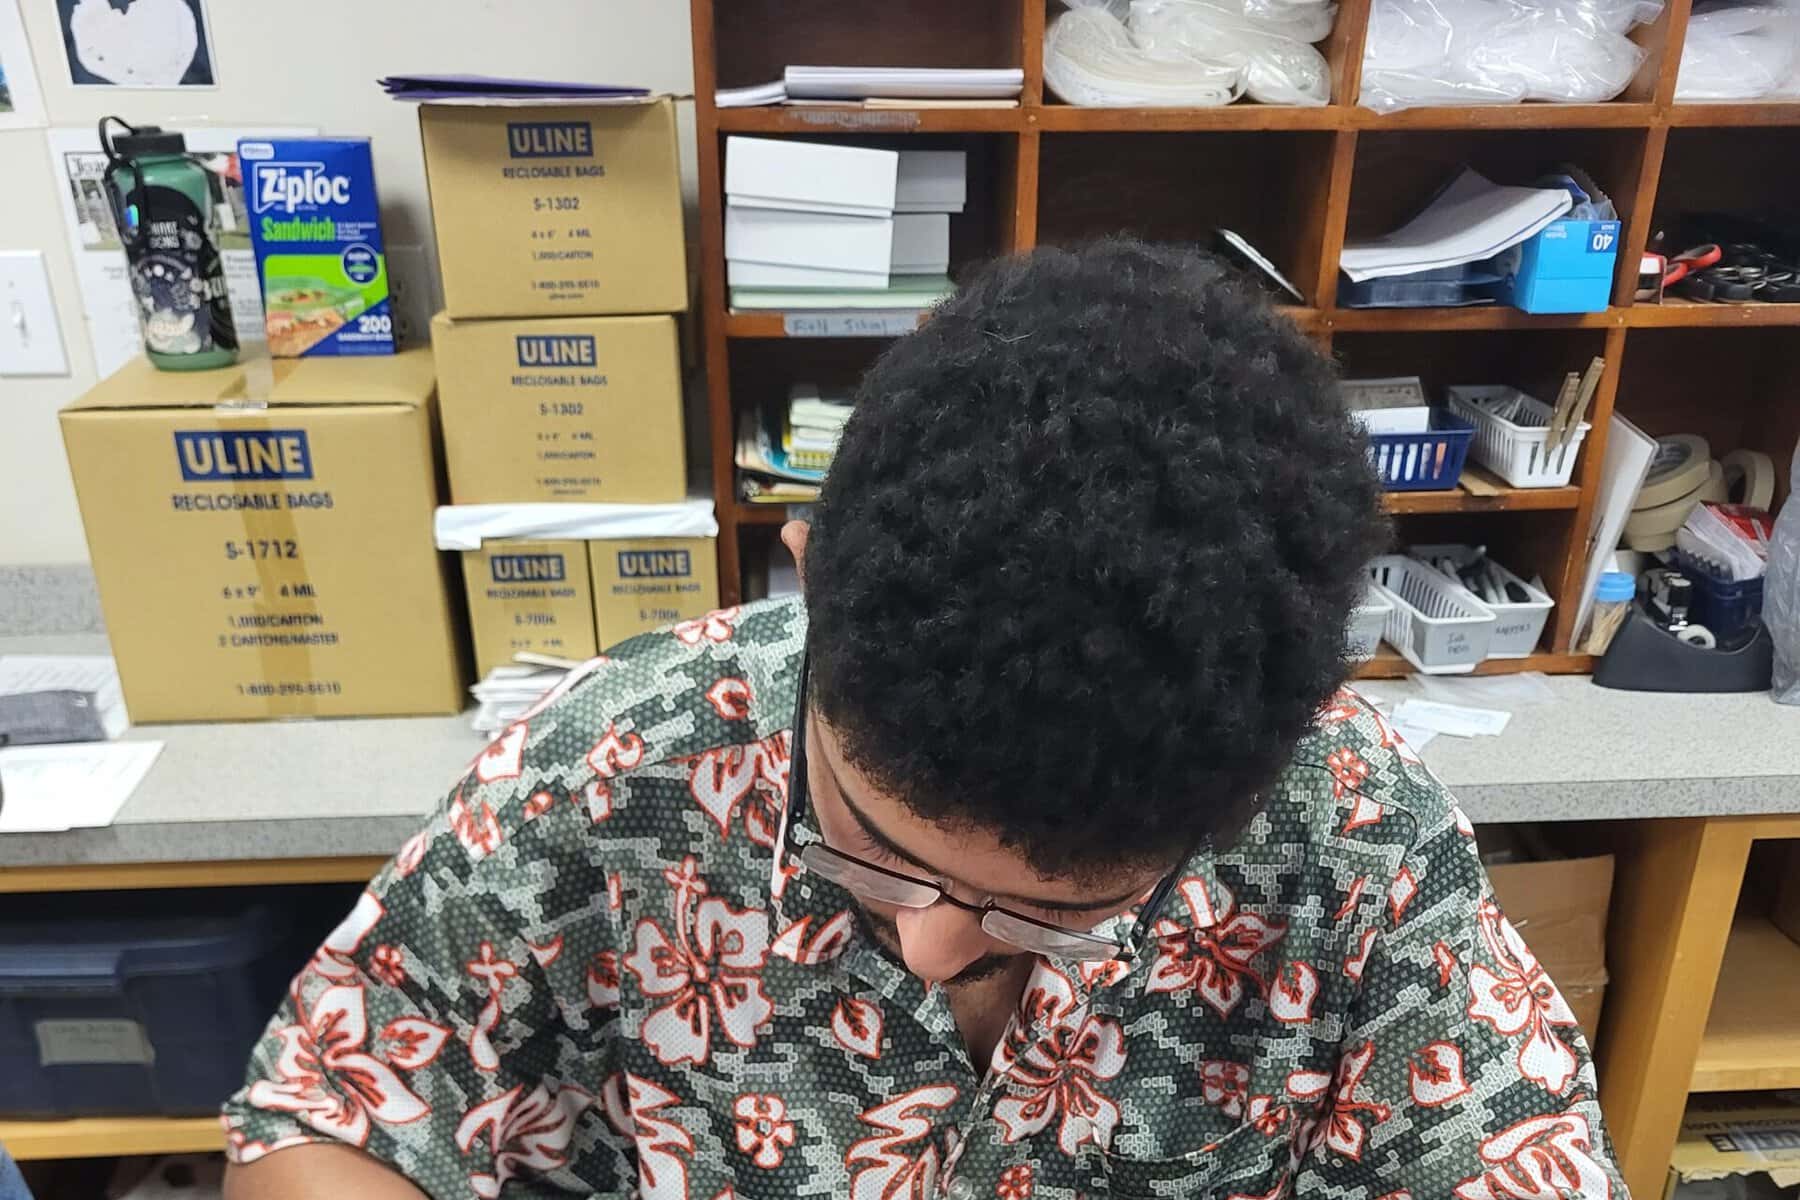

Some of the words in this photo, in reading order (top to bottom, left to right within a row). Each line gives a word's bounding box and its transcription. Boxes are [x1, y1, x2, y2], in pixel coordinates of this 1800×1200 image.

[512, 128, 588, 152] ULINE
[503, 166, 571, 179] RECLOSABLE
[576, 165, 605, 176] BAGS
[259, 168, 350, 213] Ziploc
[534, 197, 580, 211] S-1302
[261, 216, 335, 241] Sandwich
[1592, 233, 1613, 250] 40
[359, 316, 391, 333] 200
[520, 340, 593, 363] ULINE
[512, 376, 575, 386] RECLOSABLE
[581, 375, 608, 385] BAGS
[540, 403, 583, 415] S-1302
[182, 438, 304, 474] ULINE
[172, 493, 280, 512] RECLOSABLE
[287, 492, 333, 509] BAGS
[226, 541, 298, 560] S-1712
[494, 558, 562, 579] ULINE
[621, 552, 688, 574] ULINE
[294, 584, 315, 597] MIL
